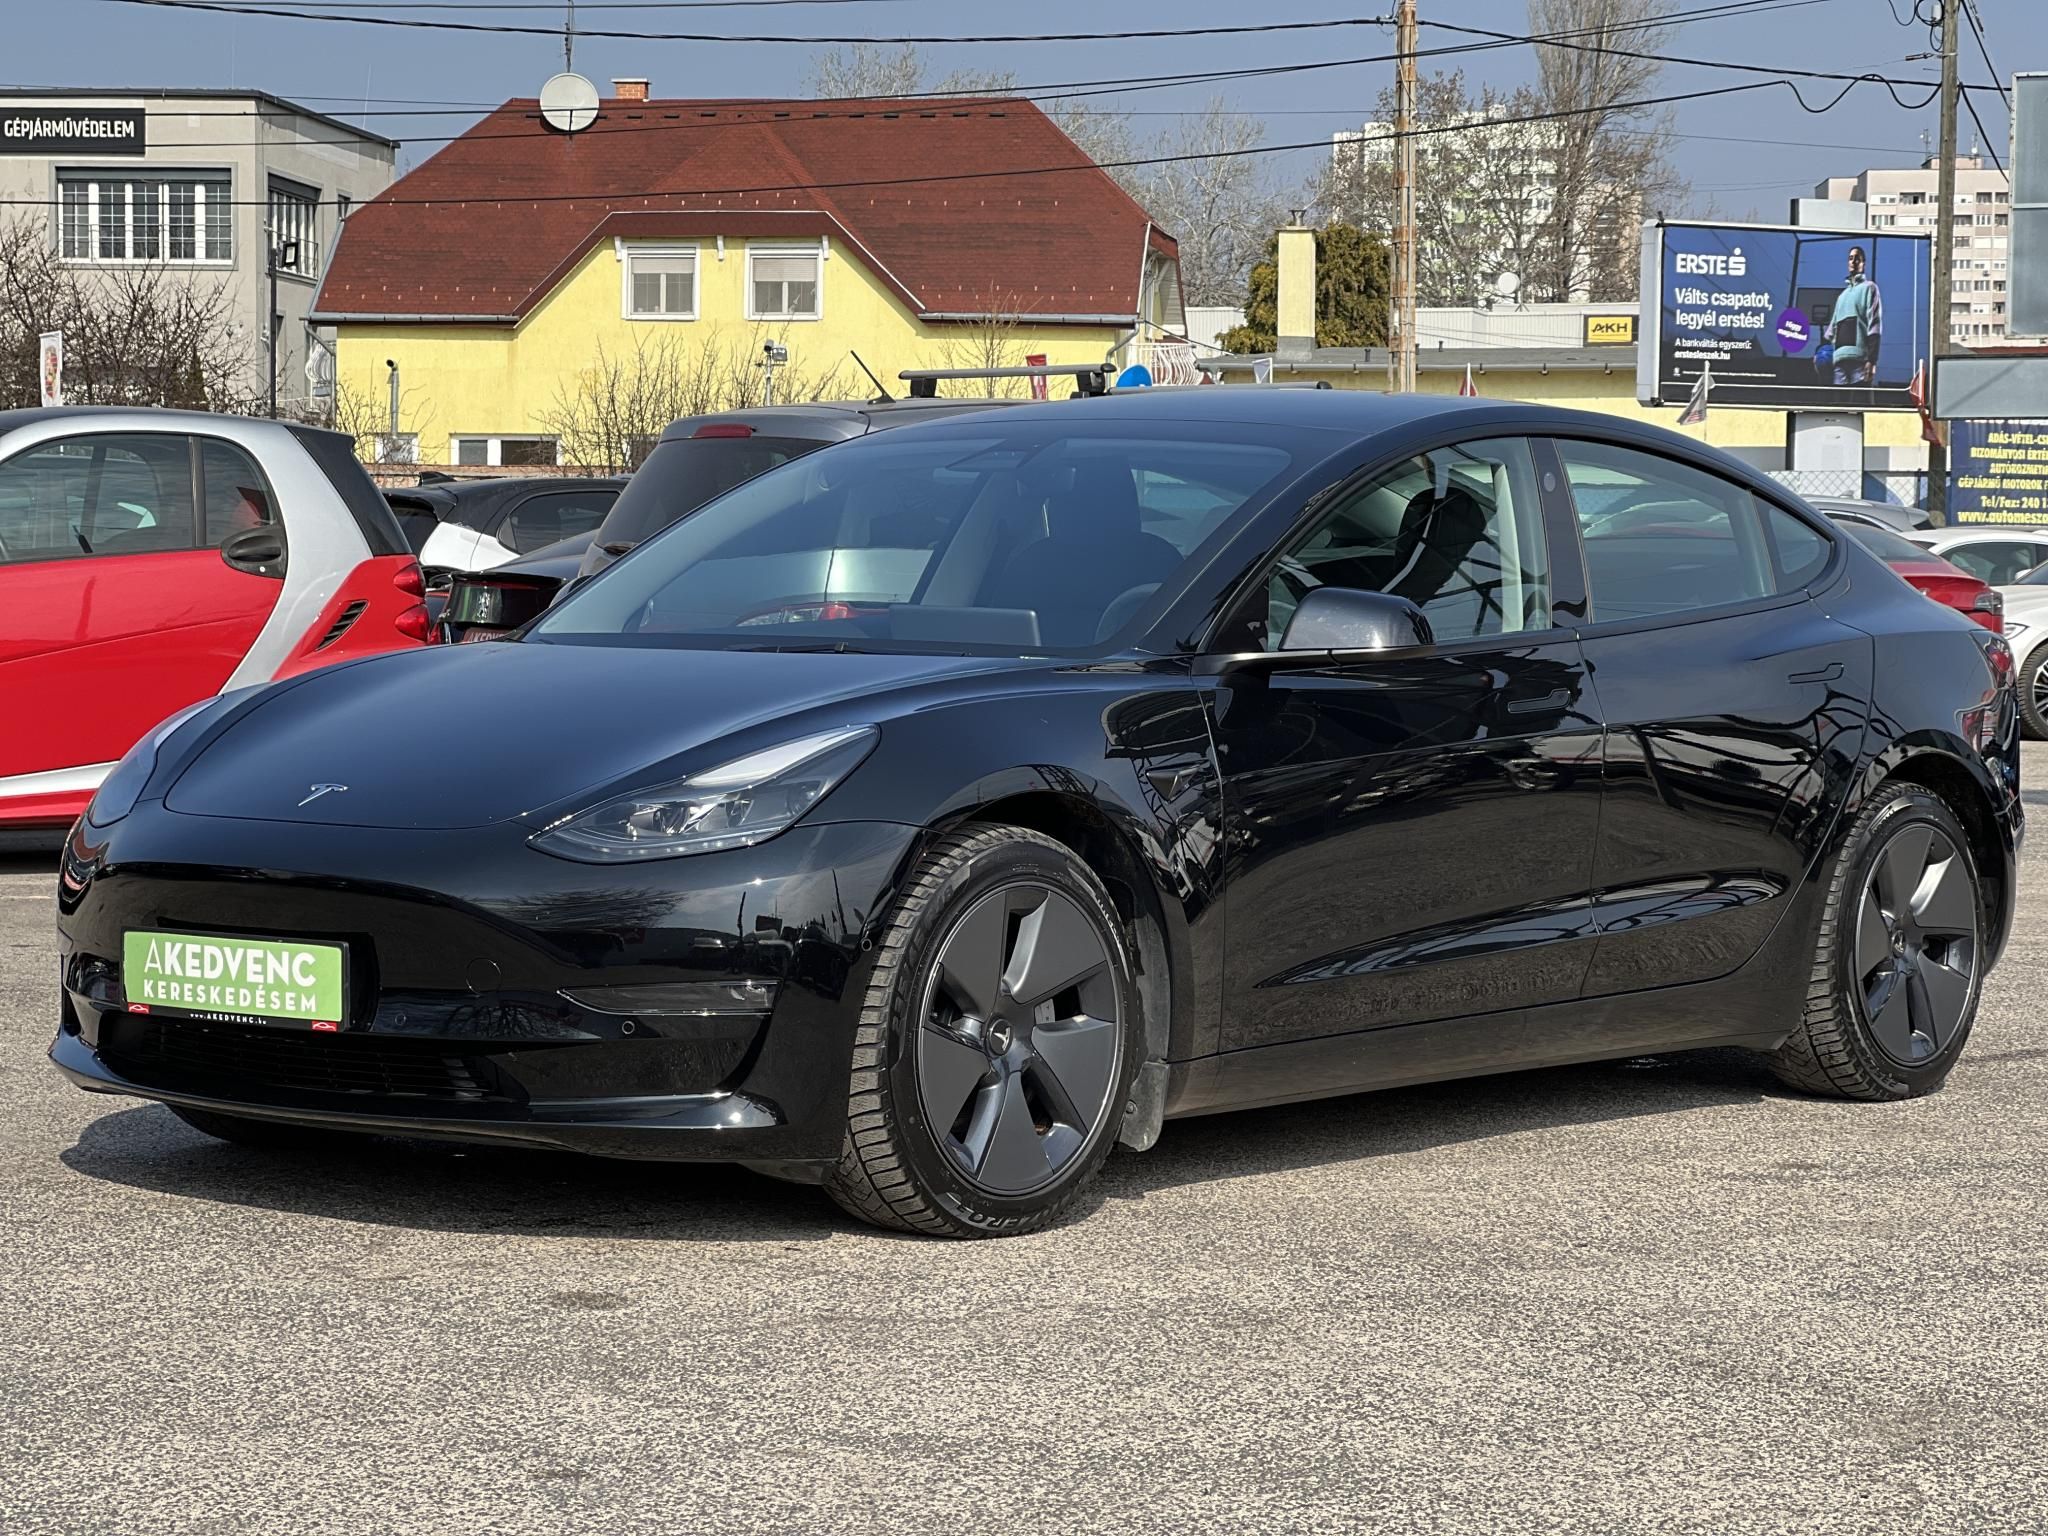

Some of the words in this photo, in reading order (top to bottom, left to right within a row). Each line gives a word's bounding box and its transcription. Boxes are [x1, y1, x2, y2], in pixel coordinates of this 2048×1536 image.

[4, 117, 135, 140] GÉPJÁRMŰVÉDELEM
[1676, 253, 1727, 275] ERSTE
[1675, 287, 1708, 305] Válts
[1711, 291, 1773, 311] csapatot,
[1592, 322, 1628, 333] AKH
[1676, 309, 1716, 330] legyél
[1718, 311, 1765, 329] erstés!
[1674, 337, 1681, 347] A
[2002, 478, 2043, 490] MOTOROK
[1981, 495, 2020, 509] Tel/Fax:
[2021, 496, 2040, 509] 240
[143, 979, 317, 1014] KERESKEDÉSEM
